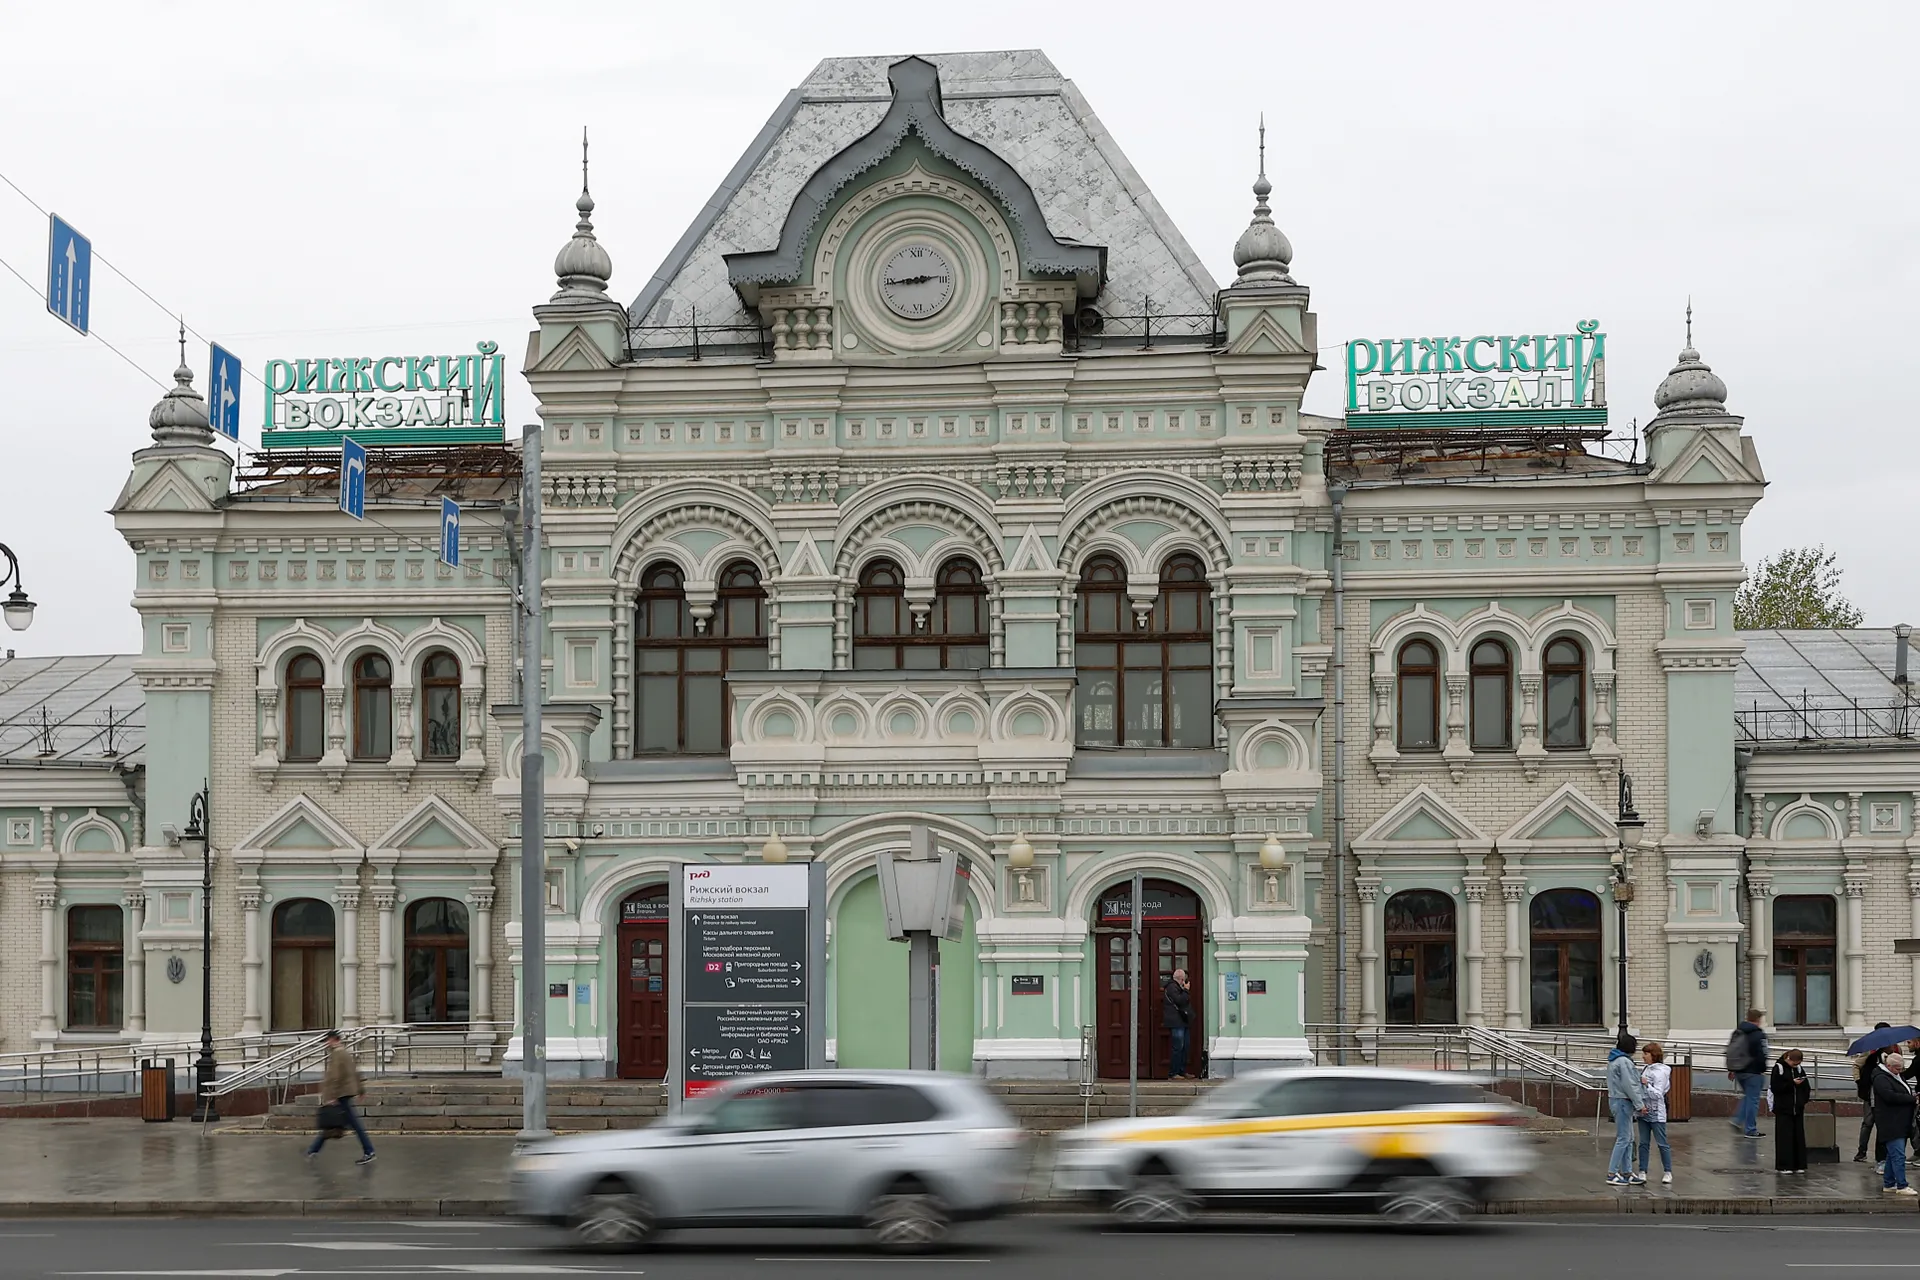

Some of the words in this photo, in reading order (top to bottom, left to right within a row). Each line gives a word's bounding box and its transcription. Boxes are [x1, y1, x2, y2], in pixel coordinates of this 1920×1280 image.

[1346, 319, 1607, 411] РИЖСКИЙ
[262, 340, 506, 429] РИЖСКИЙ
[1368, 375, 1563, 411] ВОКЗАЛ
[284, 395, 465, 429] ВОКЗАЛ
[689, 884, 733, 894] Рижский
[689, 896, 717, 905] Rizhsky
